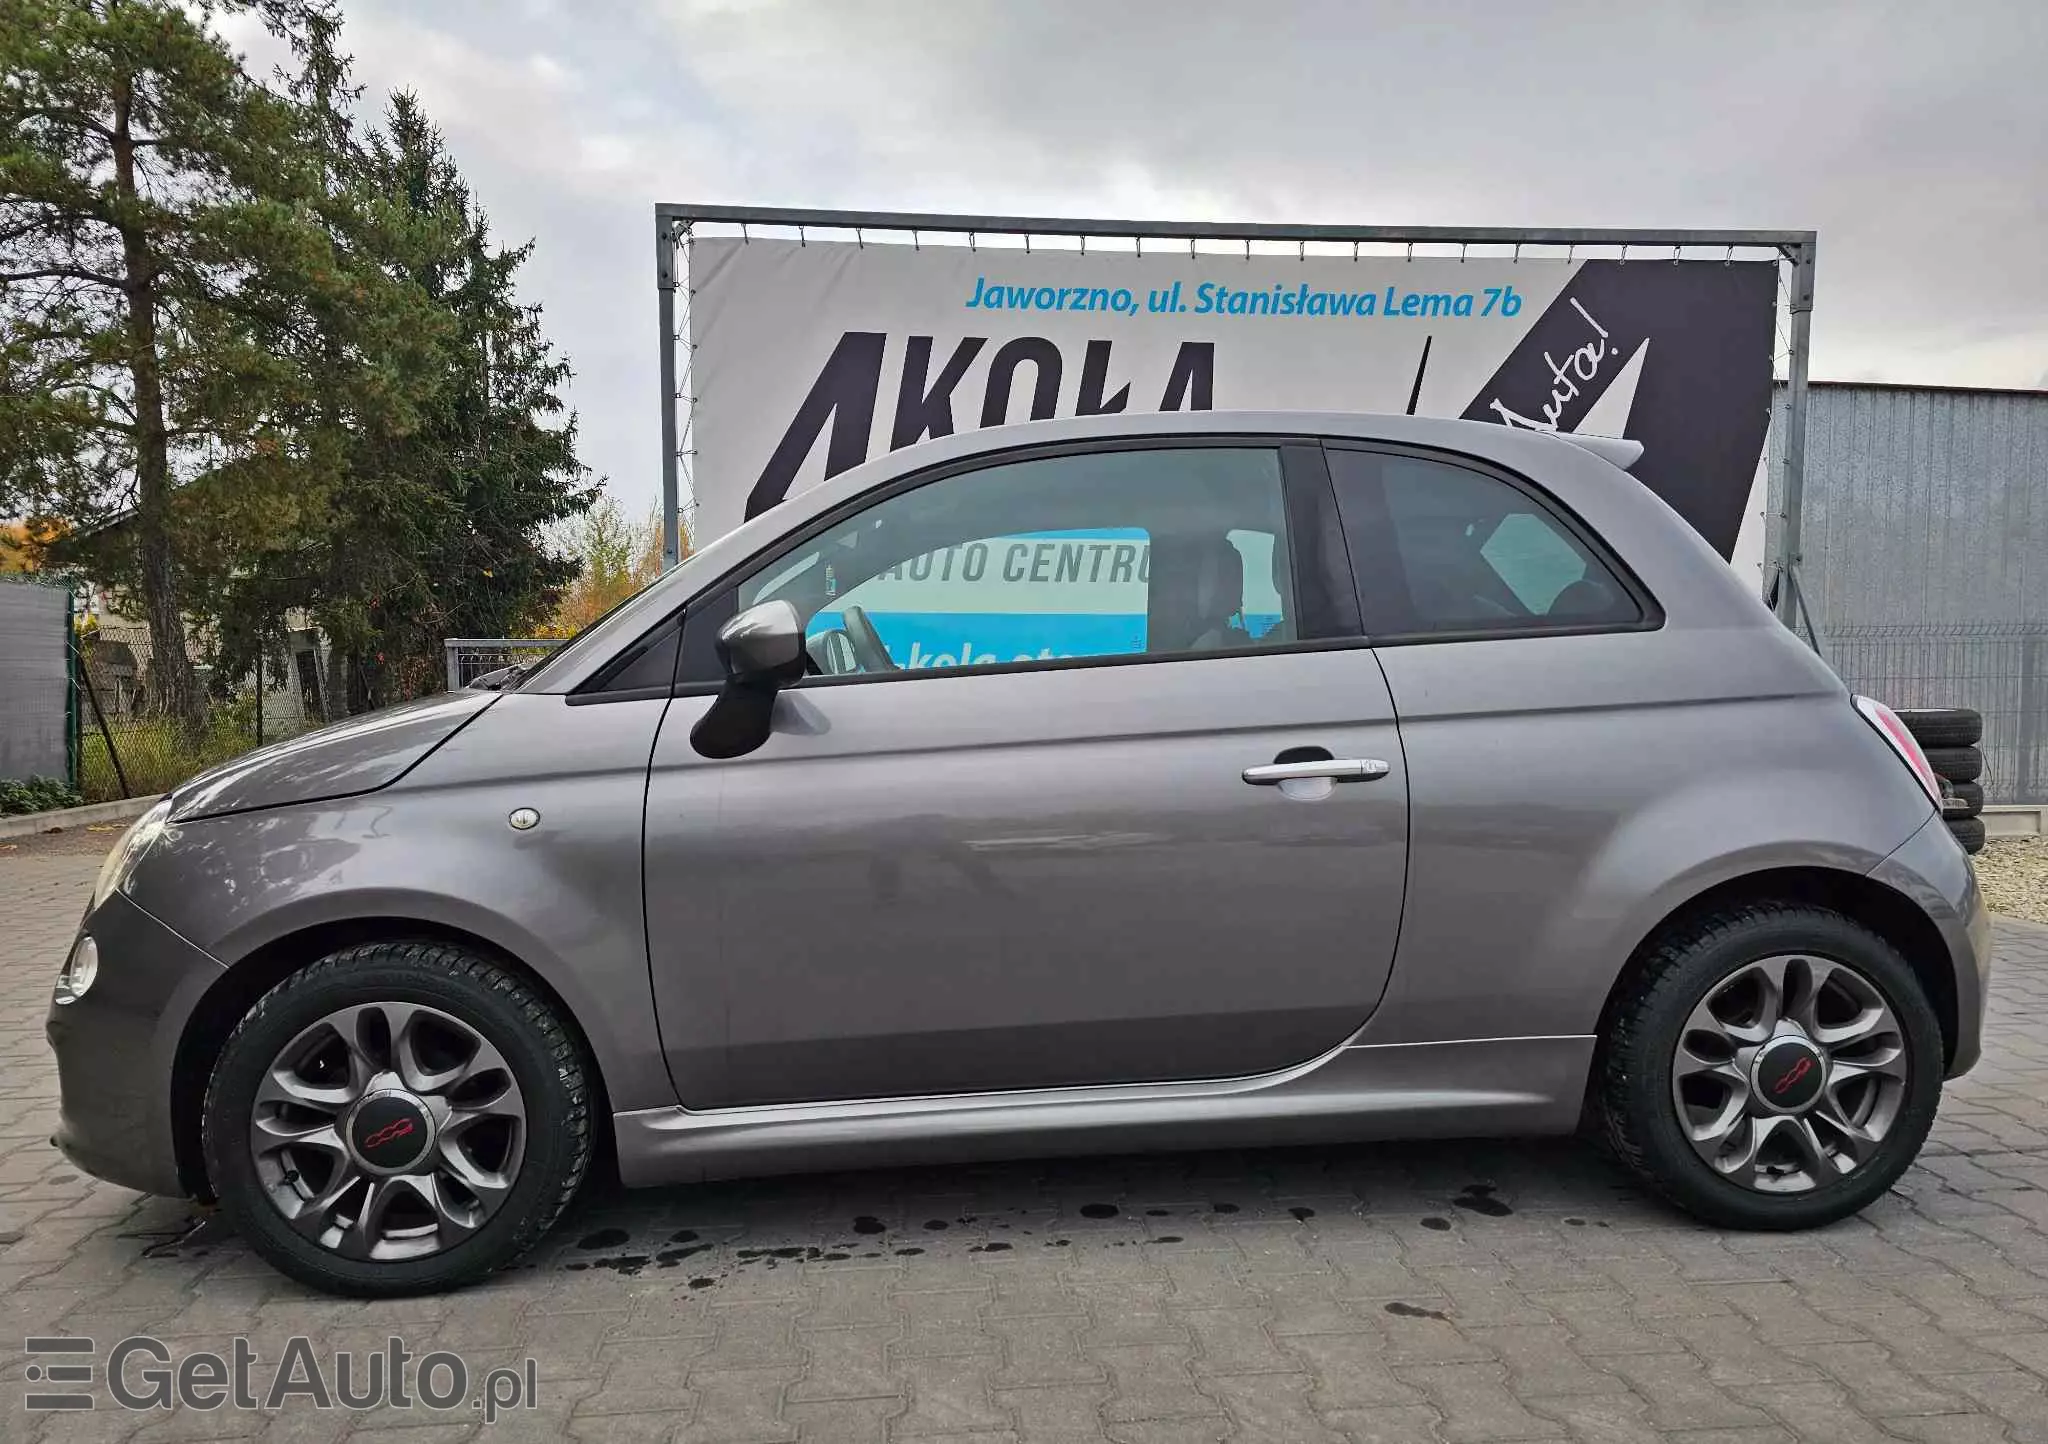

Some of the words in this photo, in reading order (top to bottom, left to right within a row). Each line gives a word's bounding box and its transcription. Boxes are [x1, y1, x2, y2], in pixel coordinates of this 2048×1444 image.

[965, 276, 1140, 316] Jaworzno,
[1148, 281, 1187, 313] ul.
[1194, 282, 1376, 317] Stanisława
[1383, 286, 1474, 317] Lema
[1480, 286, 1522, 318] 7b
